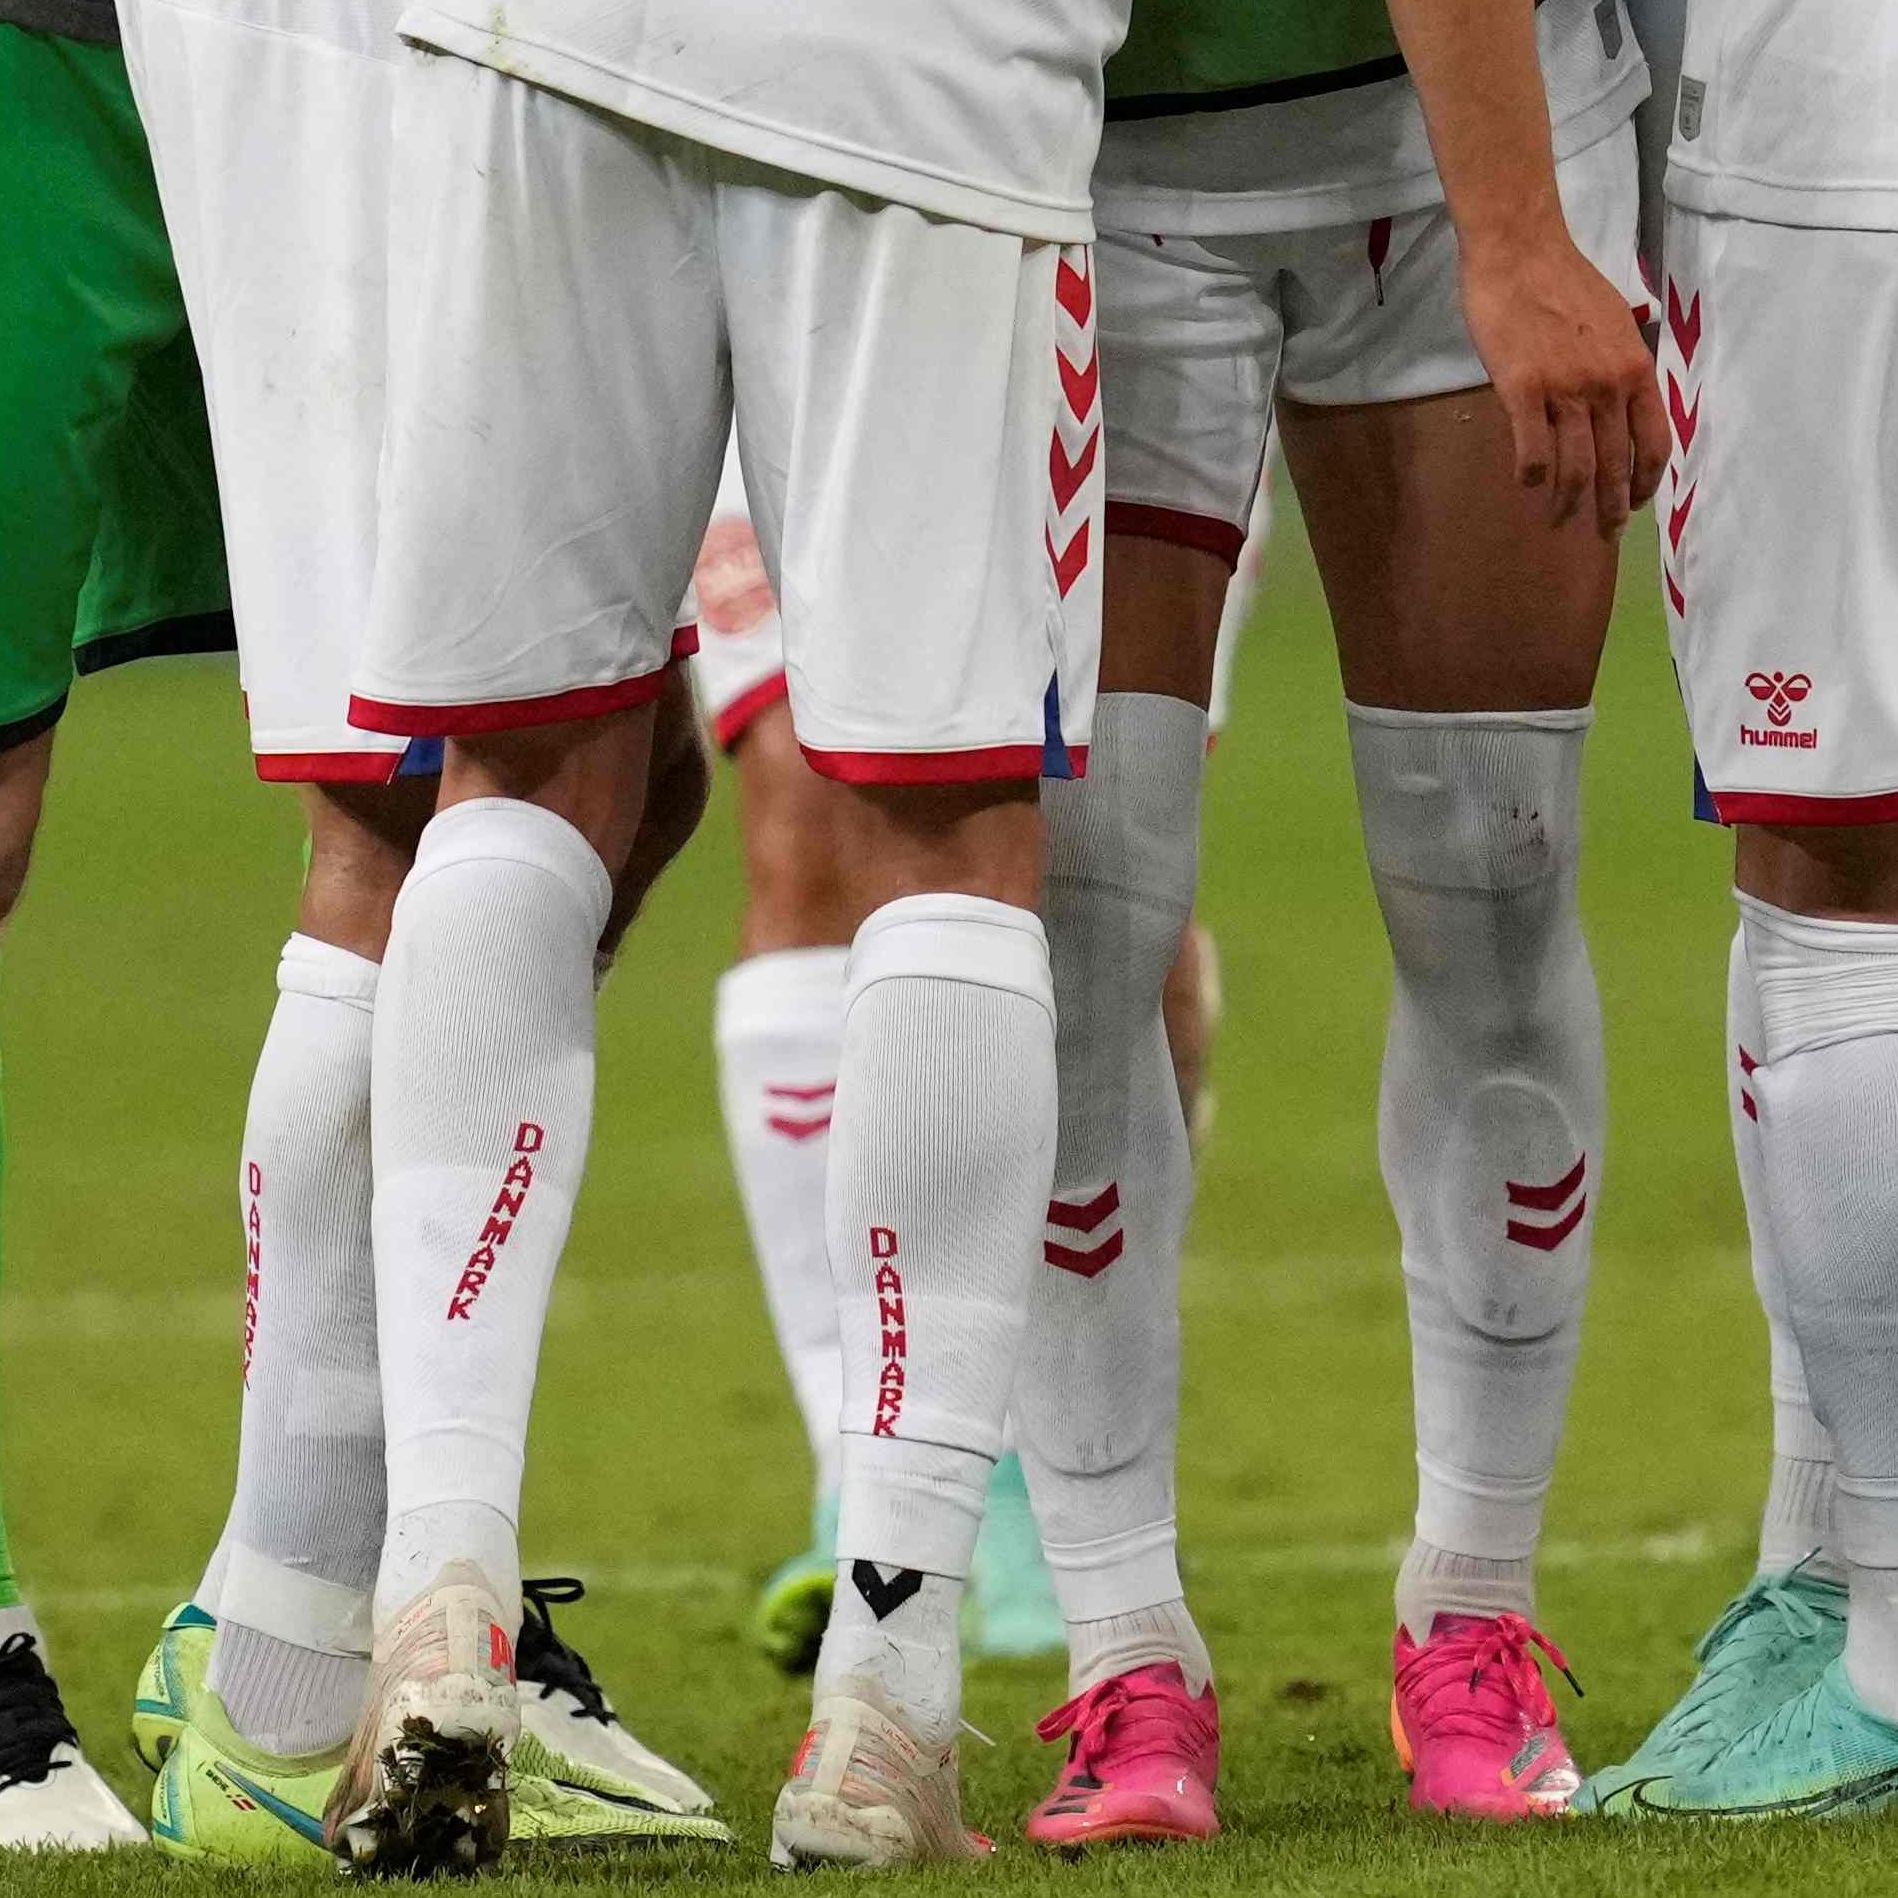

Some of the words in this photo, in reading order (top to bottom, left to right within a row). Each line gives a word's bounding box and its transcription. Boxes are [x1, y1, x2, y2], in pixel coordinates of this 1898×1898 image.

[1741, 724, 1817, 749] hummel
[447, 1122, 544, 1320] DANMARK
[870, 1227, 907, 1436] DANMARK
